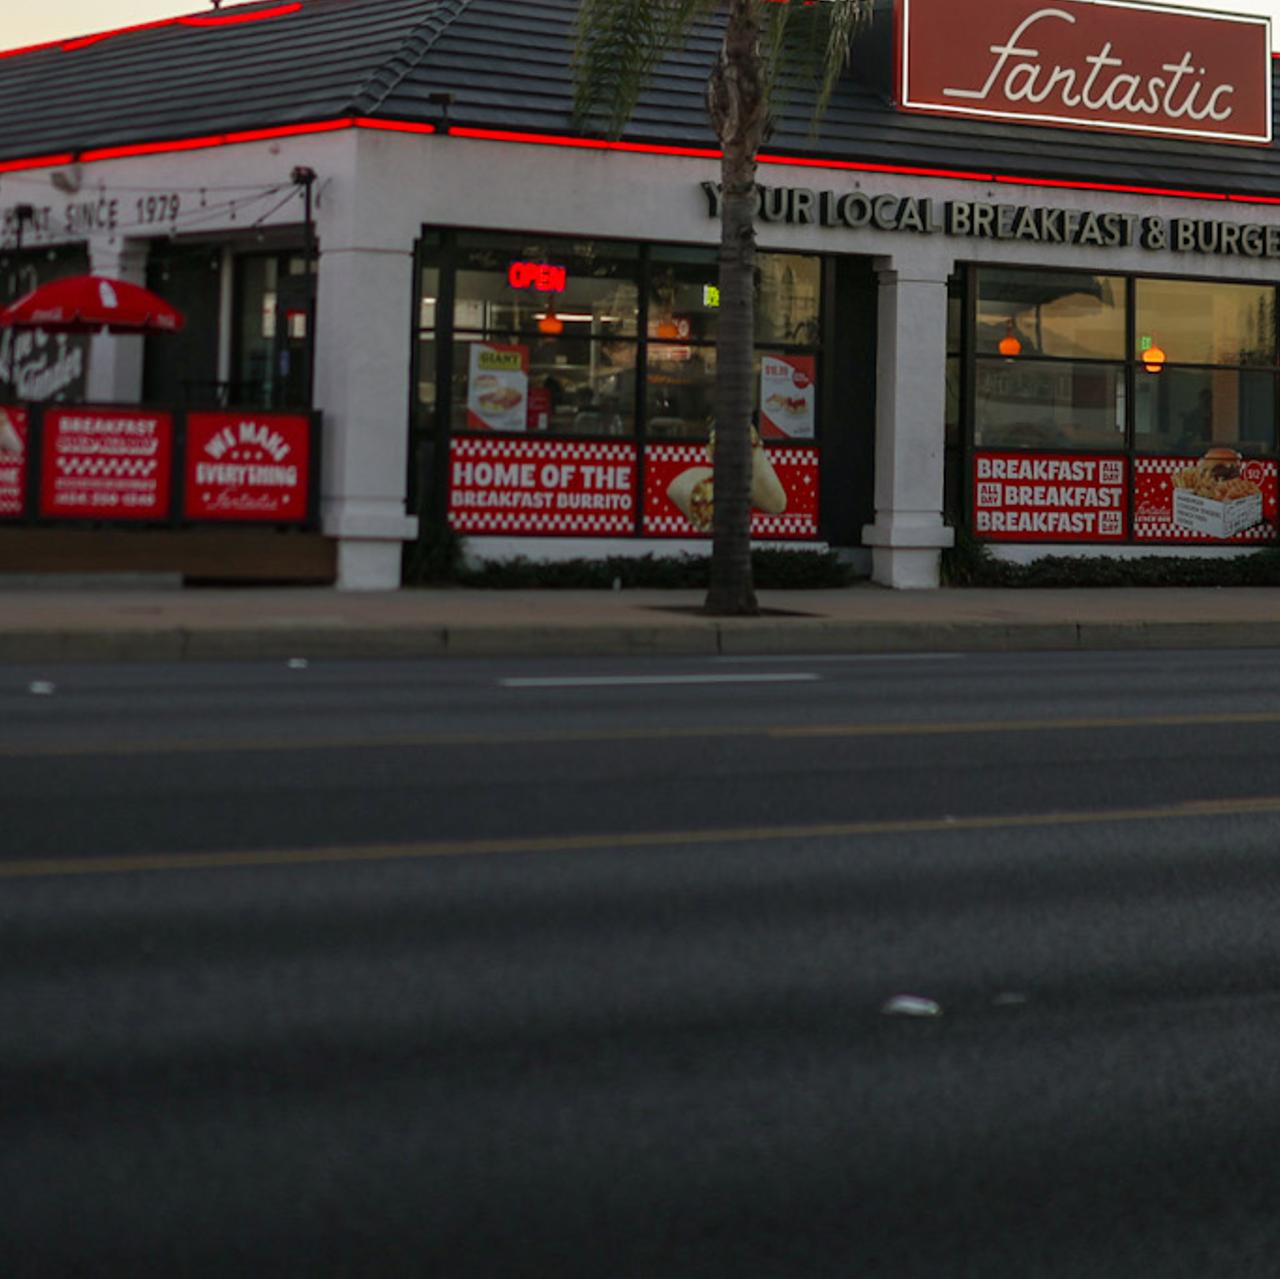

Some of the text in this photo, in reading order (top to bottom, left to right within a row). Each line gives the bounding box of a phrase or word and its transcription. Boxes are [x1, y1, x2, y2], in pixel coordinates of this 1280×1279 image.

[66, 199, 118, 231] SINCE
[137, 194, 180, 223] 1979
[821, 191, 945, 234] LOCAL
[945, 200, 1138, 247] BREAKFAST
[1140, 218, 1167, 250] &
[508, 261, 566, 292] OPEN
[480, 353, 519, 365] GIANT
[59, 417, 157, 435] BREAKFAST
[238, 421, 291, 462] MAKE
[195, 462, 298, 487] EVERYTHING
[452, 462, 632, 490] HOME OF THE
[977, 458, 1096, 481] BREAKFAST
[451, 489, 632, 510] BREAKFAST BURRITO
[1005, 485, 1122, 507] BREAKFAST
[977, 510, 1095, 533] BREAKFAST
